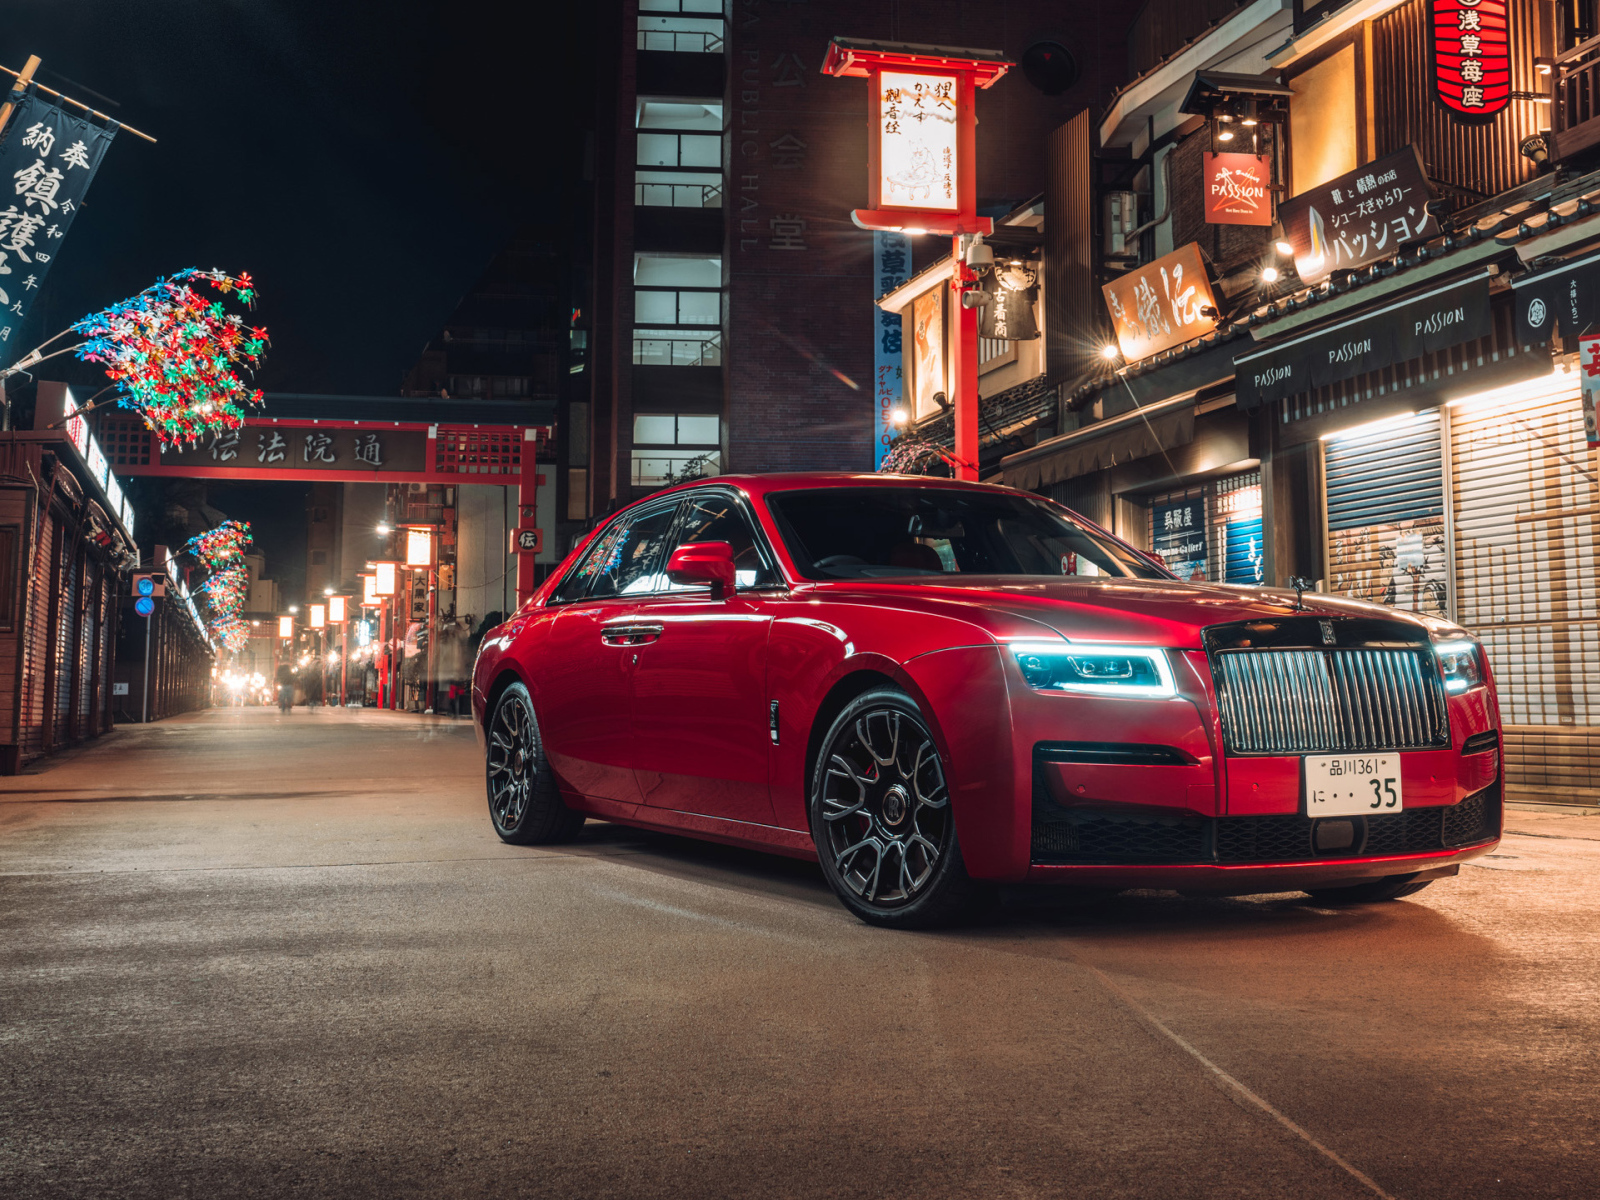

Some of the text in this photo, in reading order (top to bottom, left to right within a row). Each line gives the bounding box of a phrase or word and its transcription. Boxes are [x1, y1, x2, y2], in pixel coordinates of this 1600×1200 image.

[1458, 9, 1485, 107] 浅草苺座
[741, 50, 760, 157] PUBLIC
[769, 52, 808, 251] 公会堂
[1211, 184, 1263, 198] PASSION
[1331, 187, 1412, 228] シューズぎゃらりー
[740, 174, 759, 252] HALL
[1333, 205, 1429, 265] パッション
[1415, 307, 1464, 336] PASSION
[1328, 338, 1372, 364] PASSION
[1254, 364, 1292, 388] PASSION
[208, 431, 383, 466] 伝法院通
[518, 532, 536, 548] 伝
[1369, 777, 1397, 809] 35
